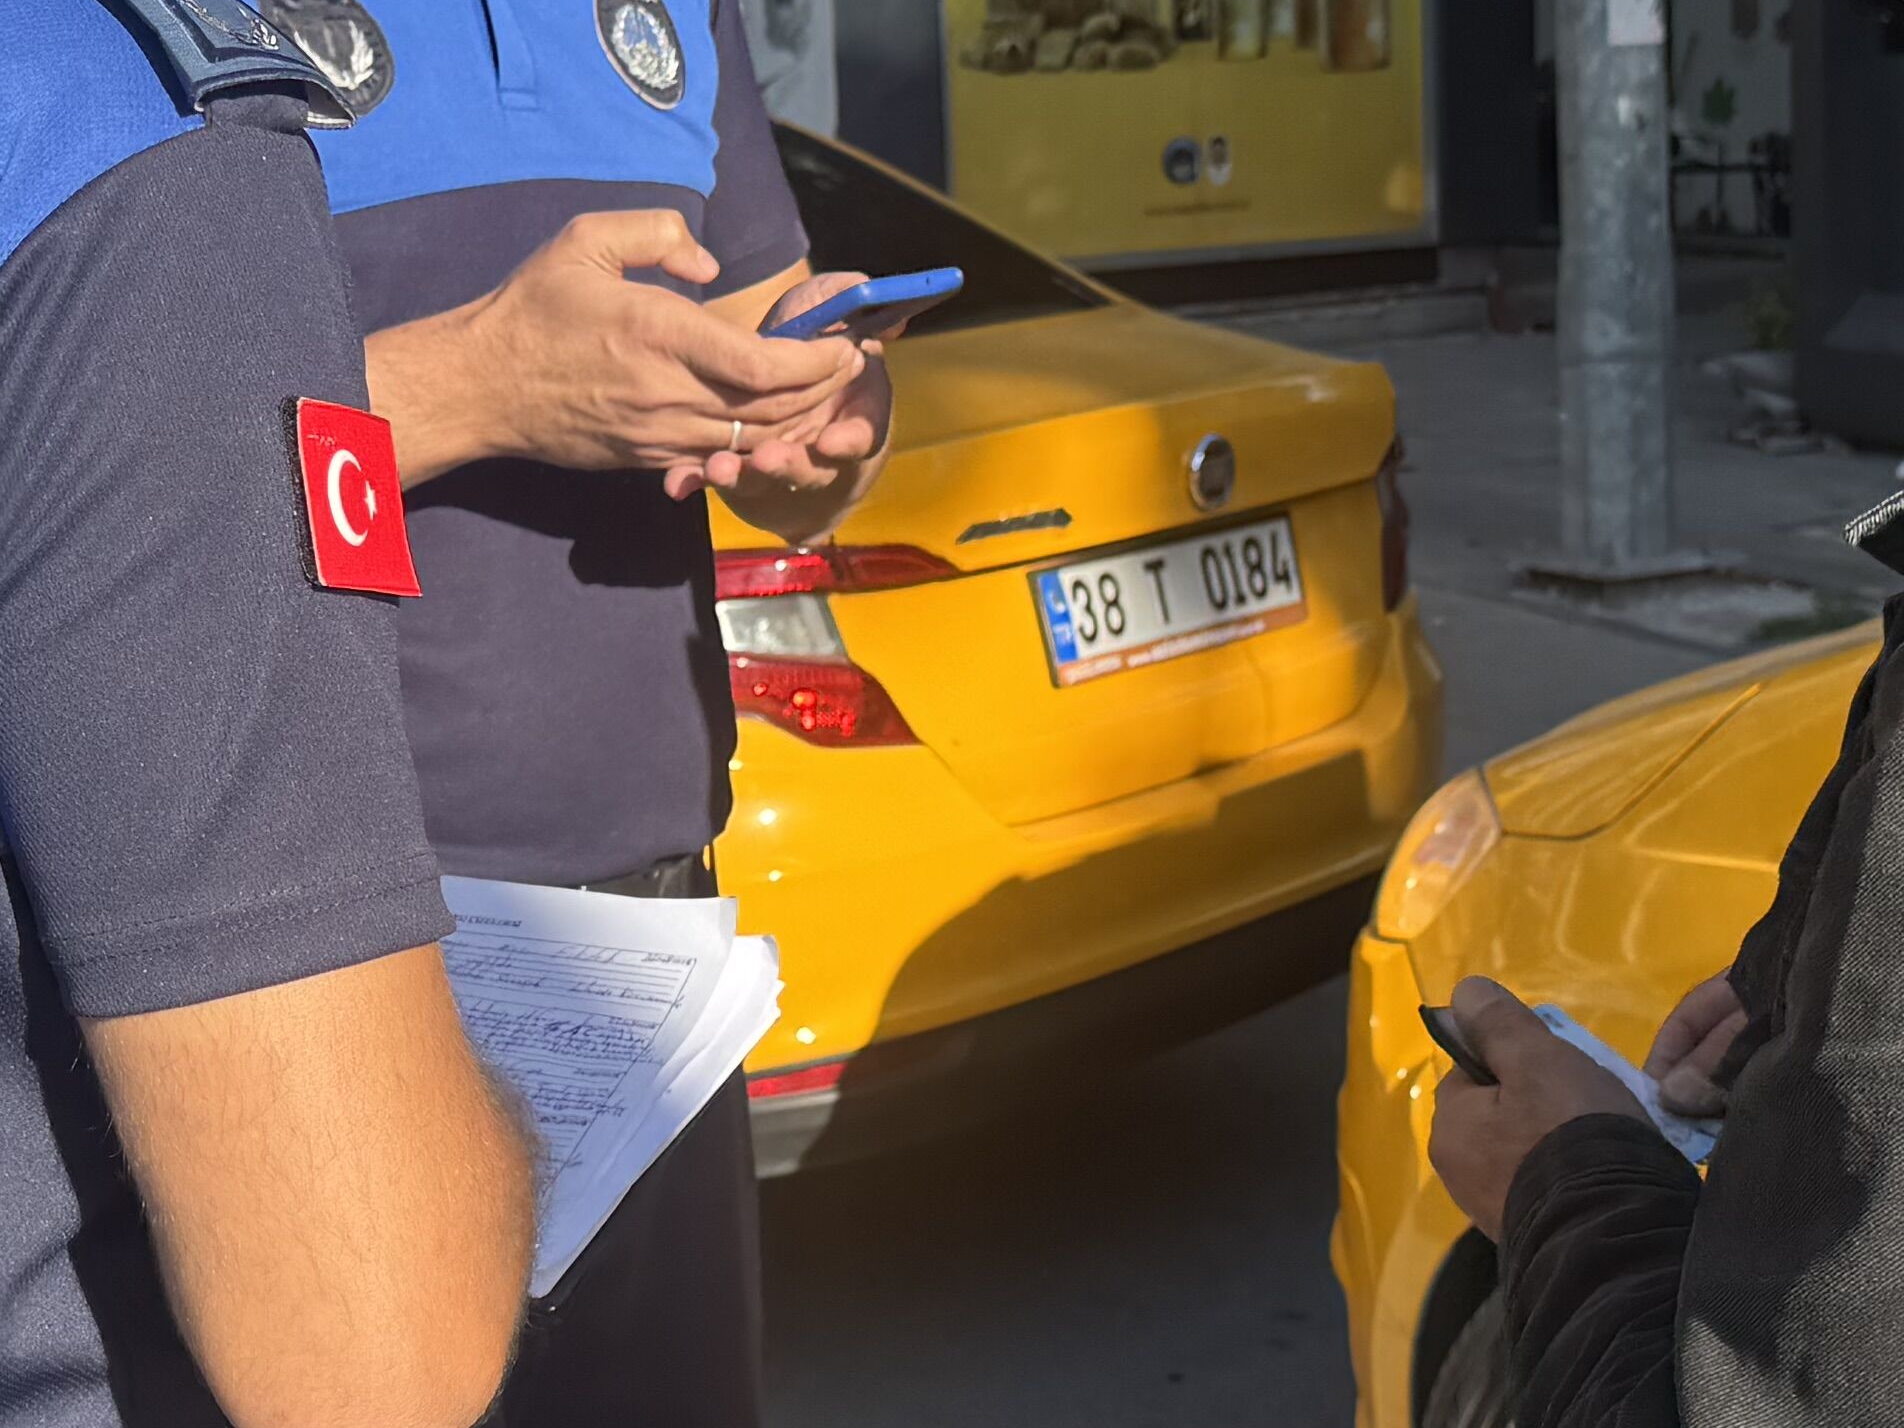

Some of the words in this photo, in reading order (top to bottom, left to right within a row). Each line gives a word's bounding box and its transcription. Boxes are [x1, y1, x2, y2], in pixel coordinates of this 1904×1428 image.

[1072, 572, 1126, 642] 38
[1143, 557, 1172, 623] T
[1200, 530, 1293, 611] 0184
